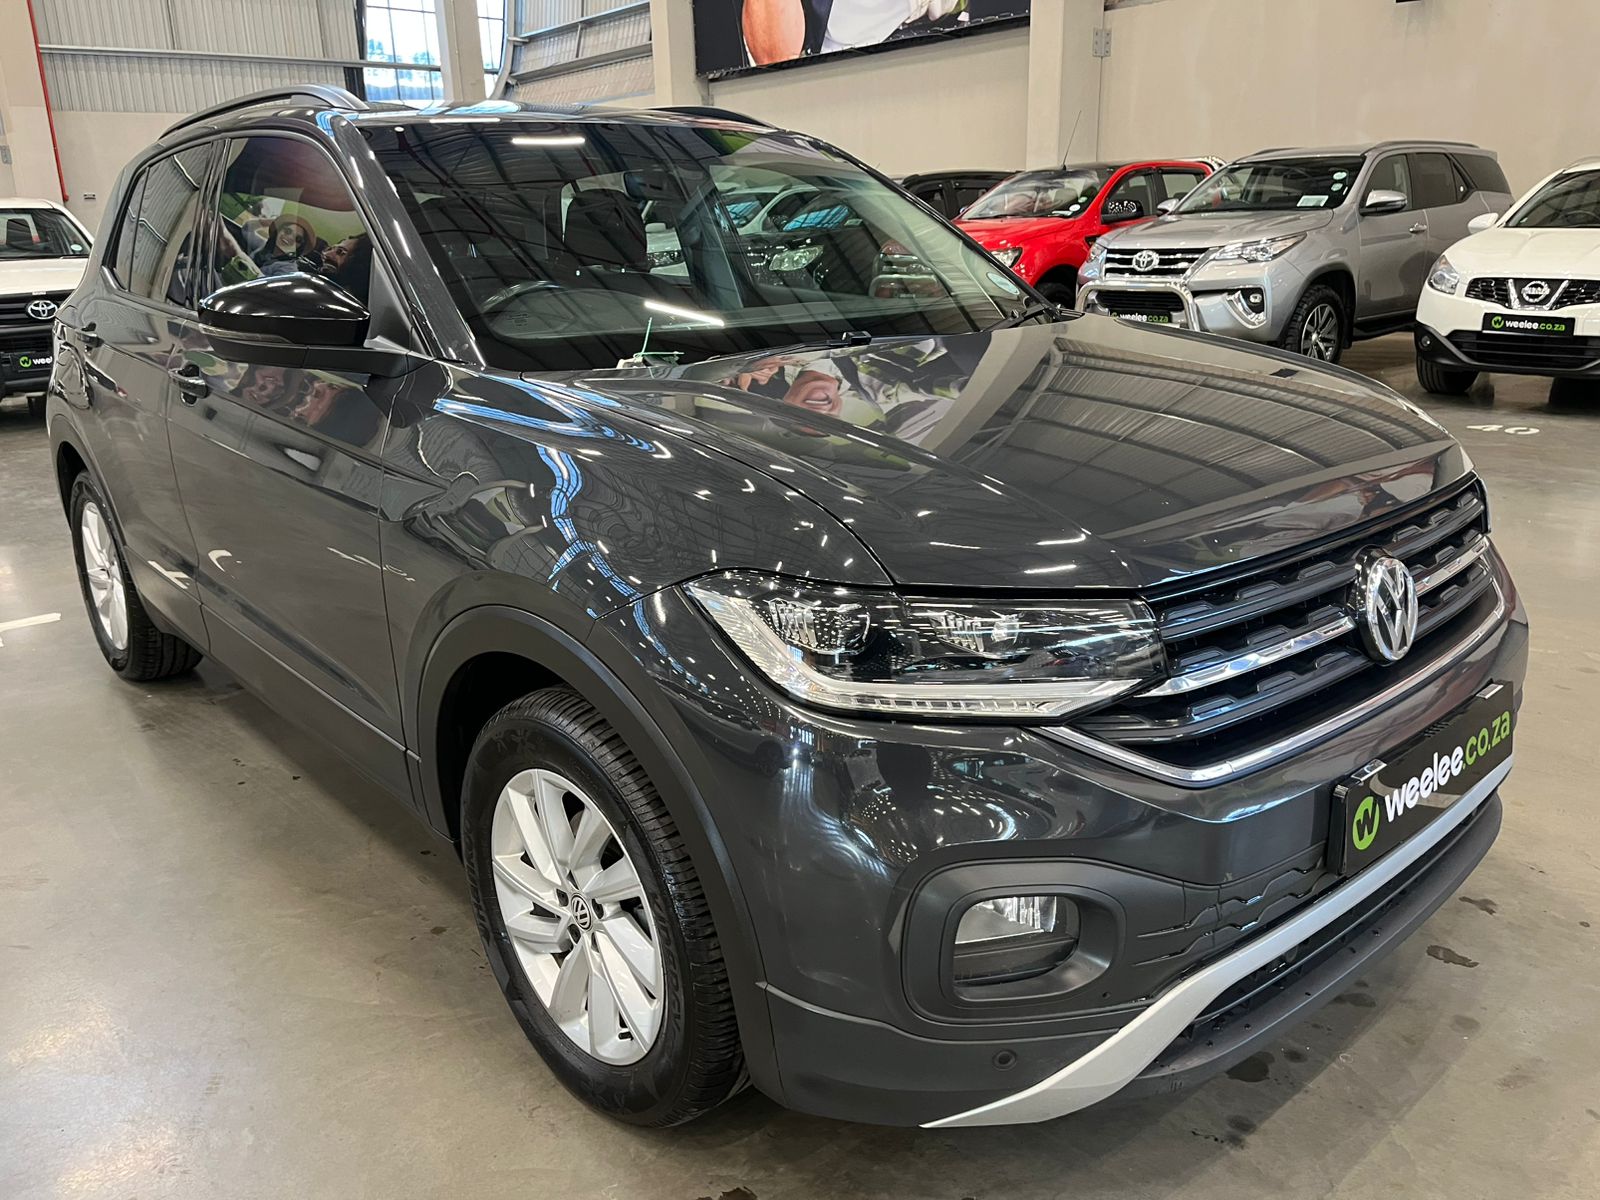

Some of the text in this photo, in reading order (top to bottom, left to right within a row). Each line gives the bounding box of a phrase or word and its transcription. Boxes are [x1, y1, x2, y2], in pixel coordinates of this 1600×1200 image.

[1119, 313, 1169, 323] weeleecoza
[1505, 320, 1566, 332] weelee.co.za
[1466, 424, 1540, 435] 40
[1384, 710, 1511, 822] weelee.co.za
